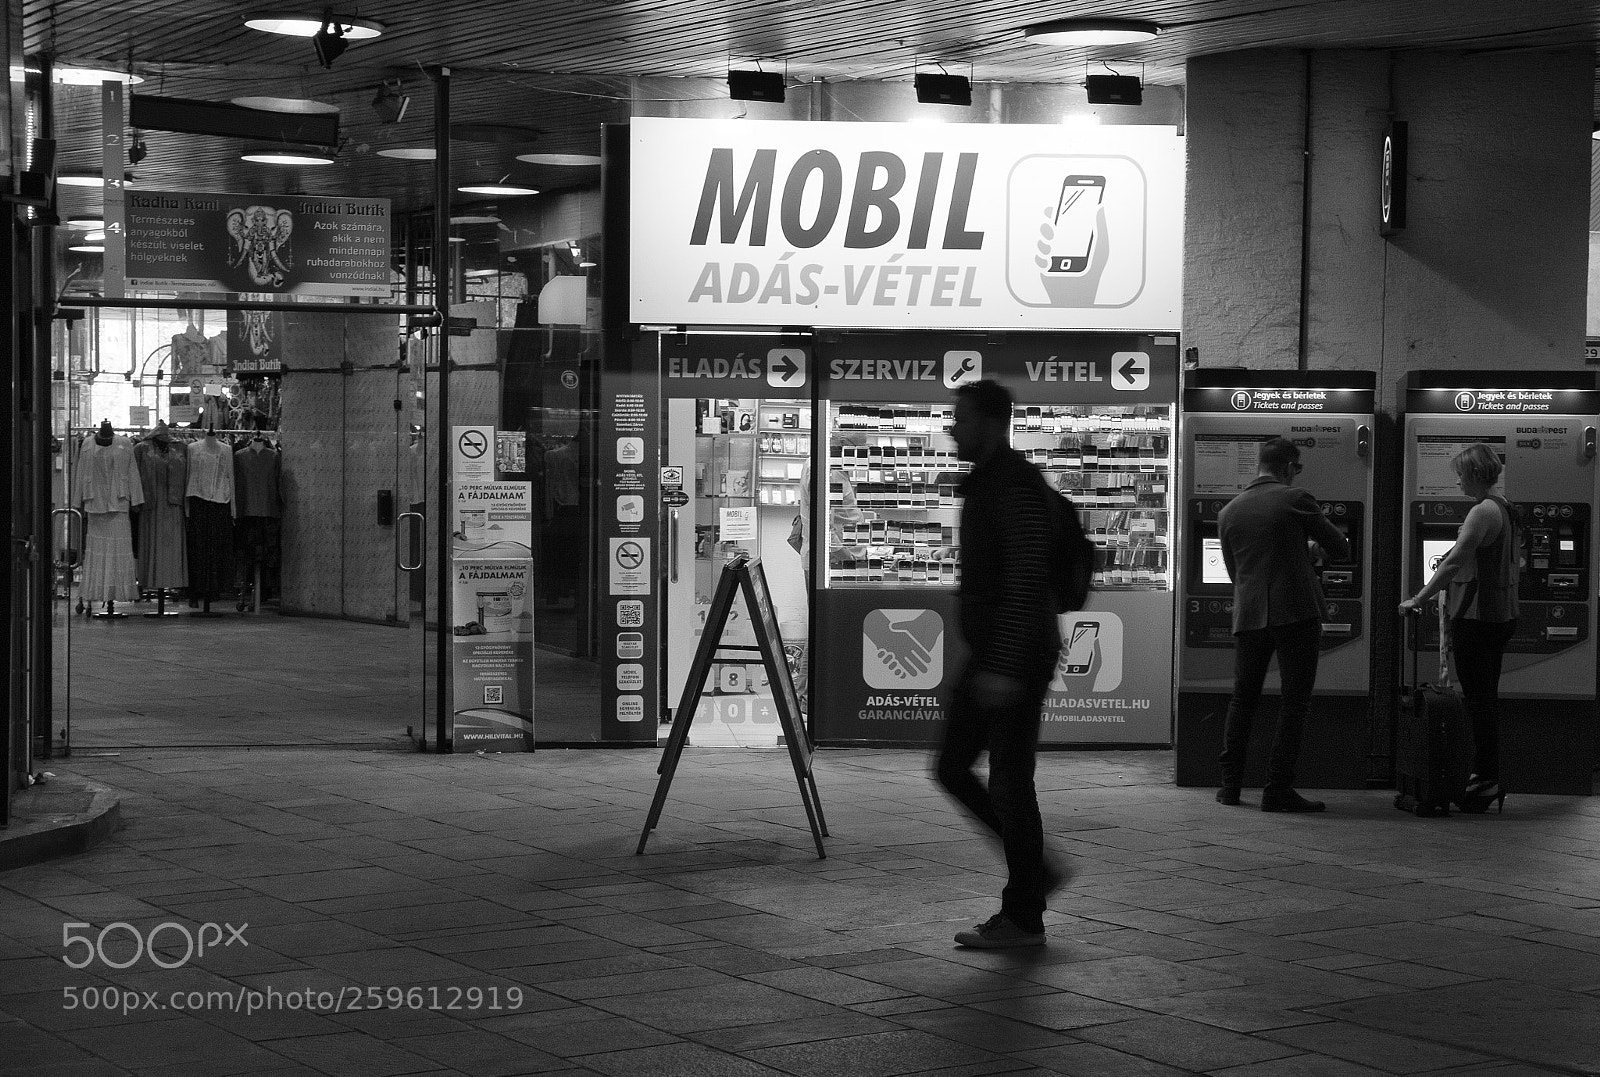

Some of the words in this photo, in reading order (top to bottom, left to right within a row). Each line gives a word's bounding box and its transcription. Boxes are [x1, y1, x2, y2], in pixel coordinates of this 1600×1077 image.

[689, 147, 985, 250] MOBIL
[346, 203, 385, 217] Butik
[130, 214, 196, 226] Természetes
[106, 222, 122, 234] 4
[130, 228, 188, 238] anyagokból
[314, 222, 338, 230] Azok
[341, 222, 385, 232] számára,
[332, 234, 354, 243] akik
[130, 240, 167, 250] készült
[170, 241, 204, 250] viselet
[329, 246, 384, 257] mindennapi
[130, 252, 188, 264] hölgyeknek
[306, 258, 385, 268] ruhadarabokhoz
[330, 271, 384, 280] vonzódnak!
[687, 252, 983, 308] ADÁS-VÉTEL
[668, 352, 762, 379] ELADÁS
[830, 358, 936, 382] SZERVIZ
[1025, 355, 1103, 382] VÉTEL
[1253, 391, 1280, 400] Jegyek
[1282, 390, 1292, 399] és
[1293, 390, 1327, 400] bérletek
[1478, 392, 1505, 401] Jegyek
[1507, 391, 1517, 400] és
[1518, 391, 1552, 400] bérletek
[1522, 404, 1549, 412] passes
[1196, 502, 1203, 514] 1
[1418, 504, 1425, 516] 1
[1191, 600, 1200, 612] 3
[728, 672, 739, 686] 8
[866, 694, 940, 707] ADÁS-VÉTEL
[858, 707, 948, 721] GARANCIÁVAL
